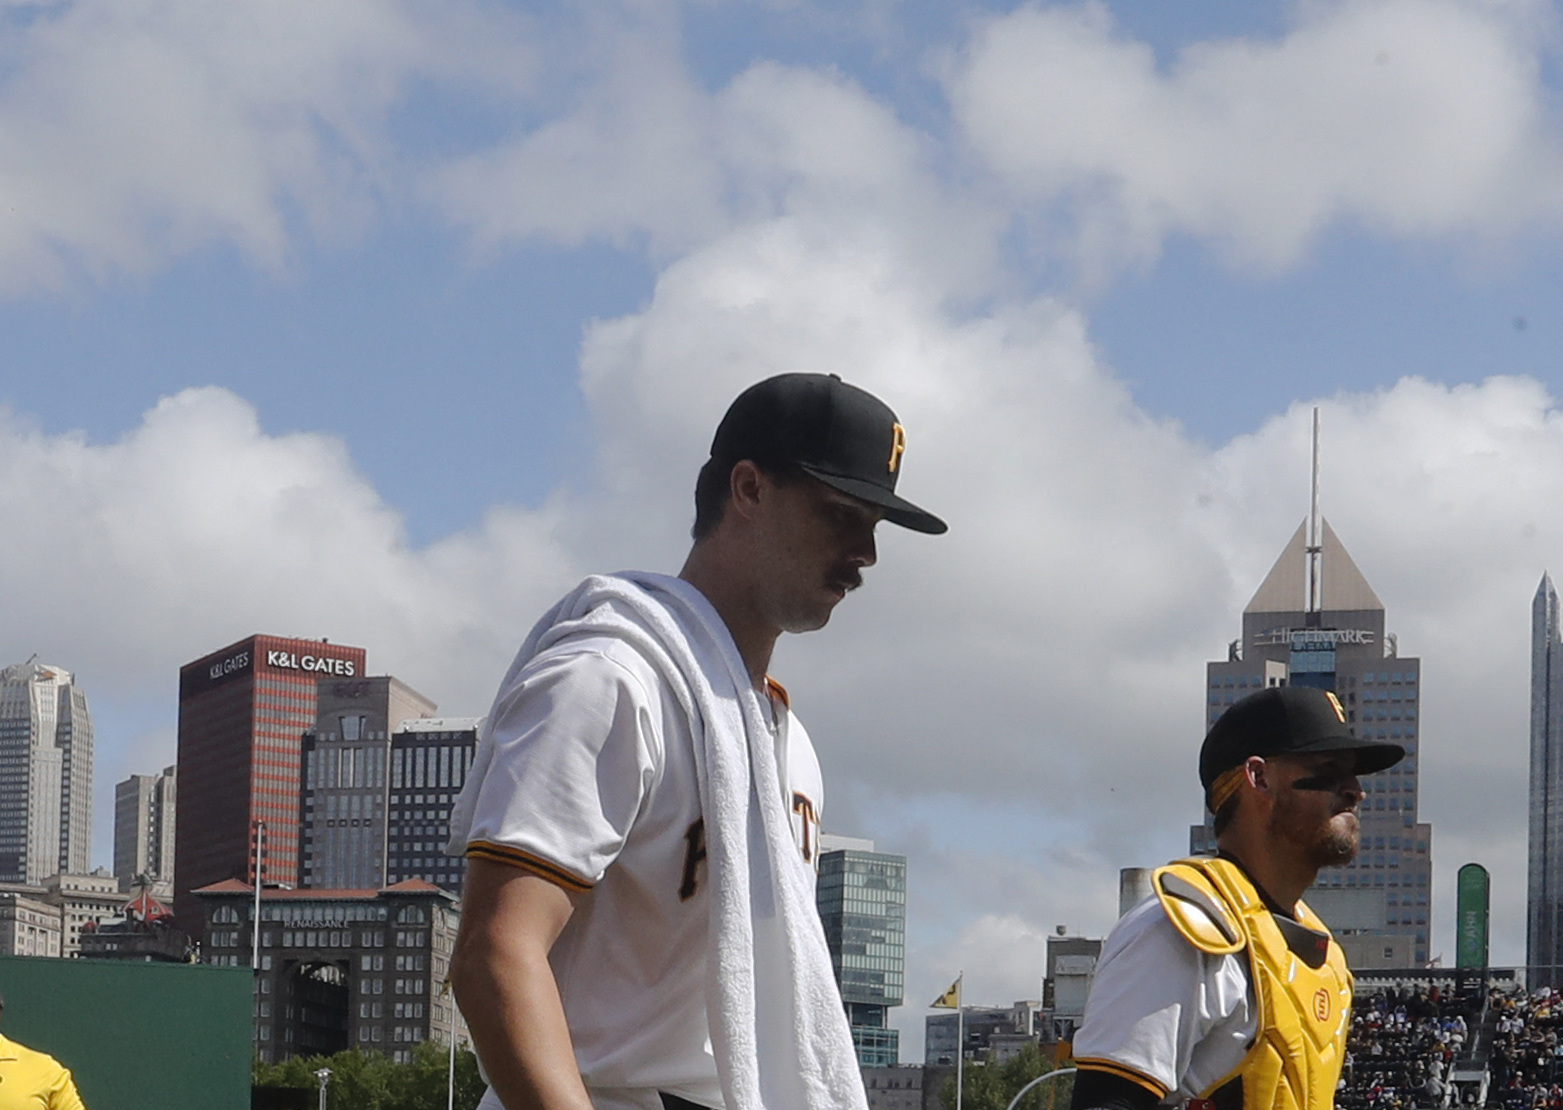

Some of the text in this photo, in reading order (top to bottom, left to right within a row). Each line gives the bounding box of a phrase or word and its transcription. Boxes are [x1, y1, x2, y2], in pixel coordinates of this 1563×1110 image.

[888, 422, 907, 473] P
[1271, 627, 1368, 645] HIGHMARK
[209, 651, 249, 679] K&L GATES
[267, 650, 355, 677] K&L GATES
[283, 919, 350, 929] RENAISSANCE
[1465, 911, 1478, 939] AHN
